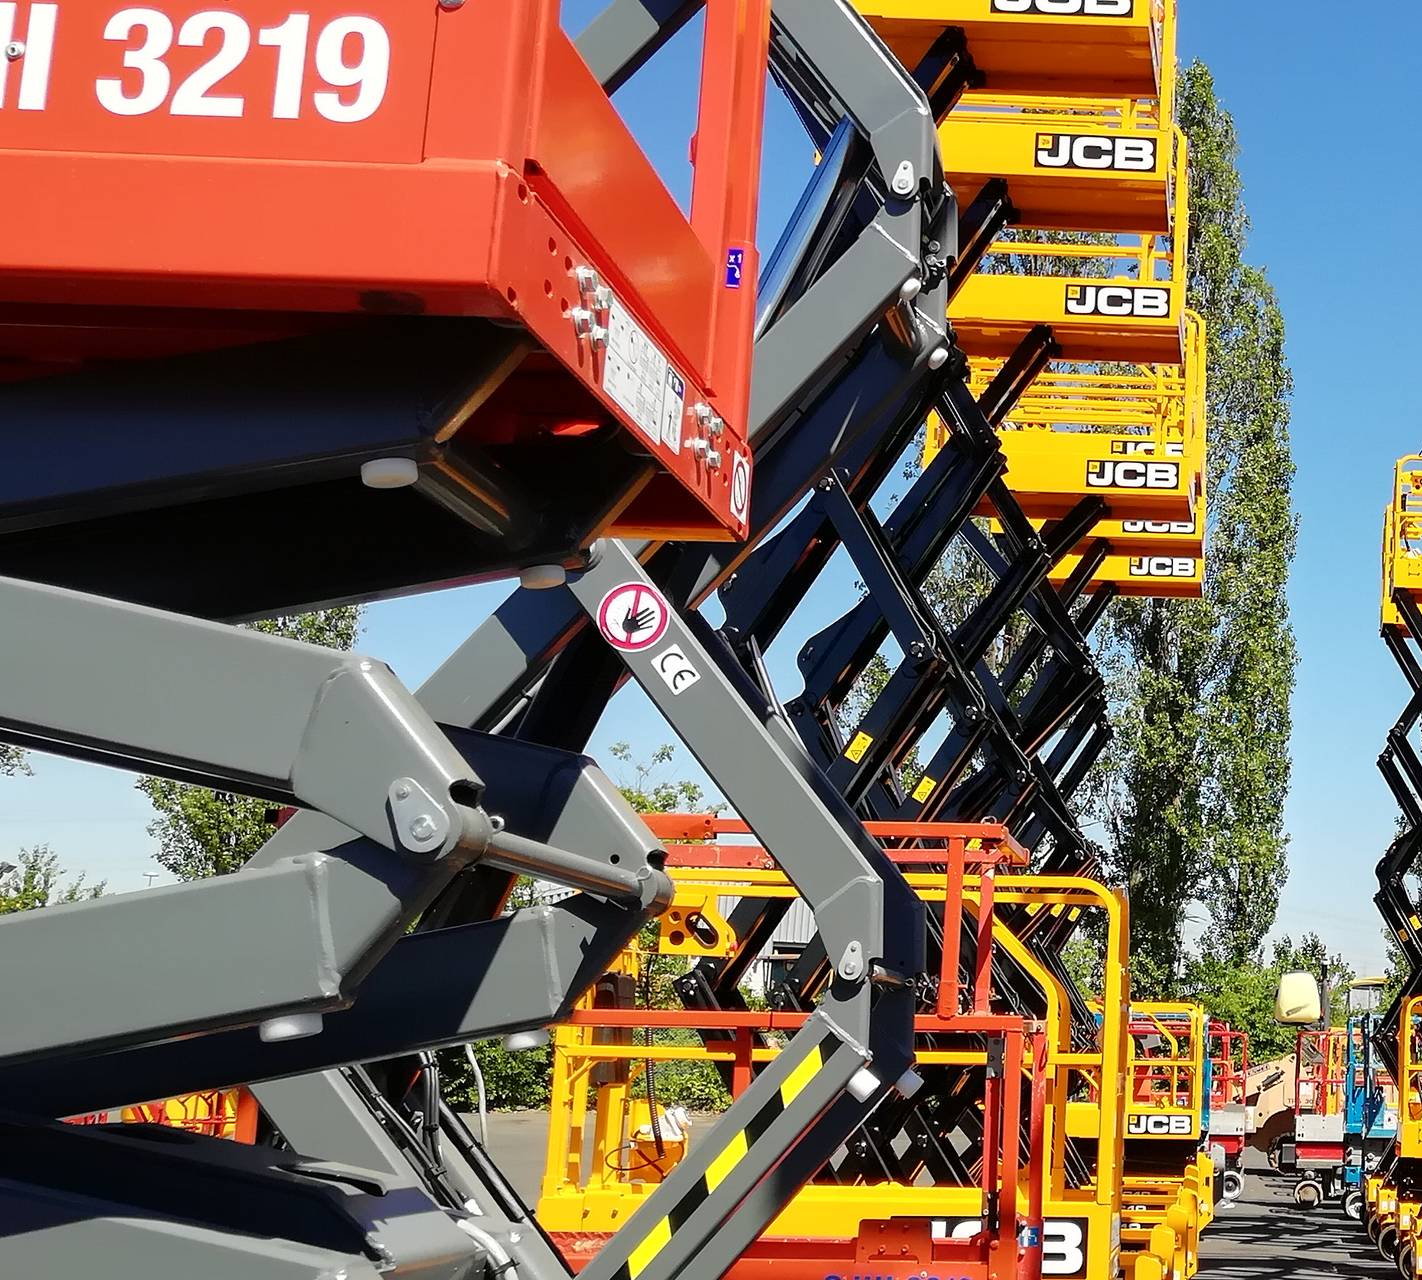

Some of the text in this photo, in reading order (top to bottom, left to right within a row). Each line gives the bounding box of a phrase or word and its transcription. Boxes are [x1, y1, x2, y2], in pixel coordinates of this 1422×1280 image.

[95, 7, 391, 123] 3219
[1036, 135, 1155, 171] JCB
[1066, 286, 1169, 318] JCB
[1087, 461, 1178, 489] JCB
[1129, 557, 1195, 577] JCB
[660, 652, 696, 690] CE
[1128, 1114, 1192, 1135] JCB
